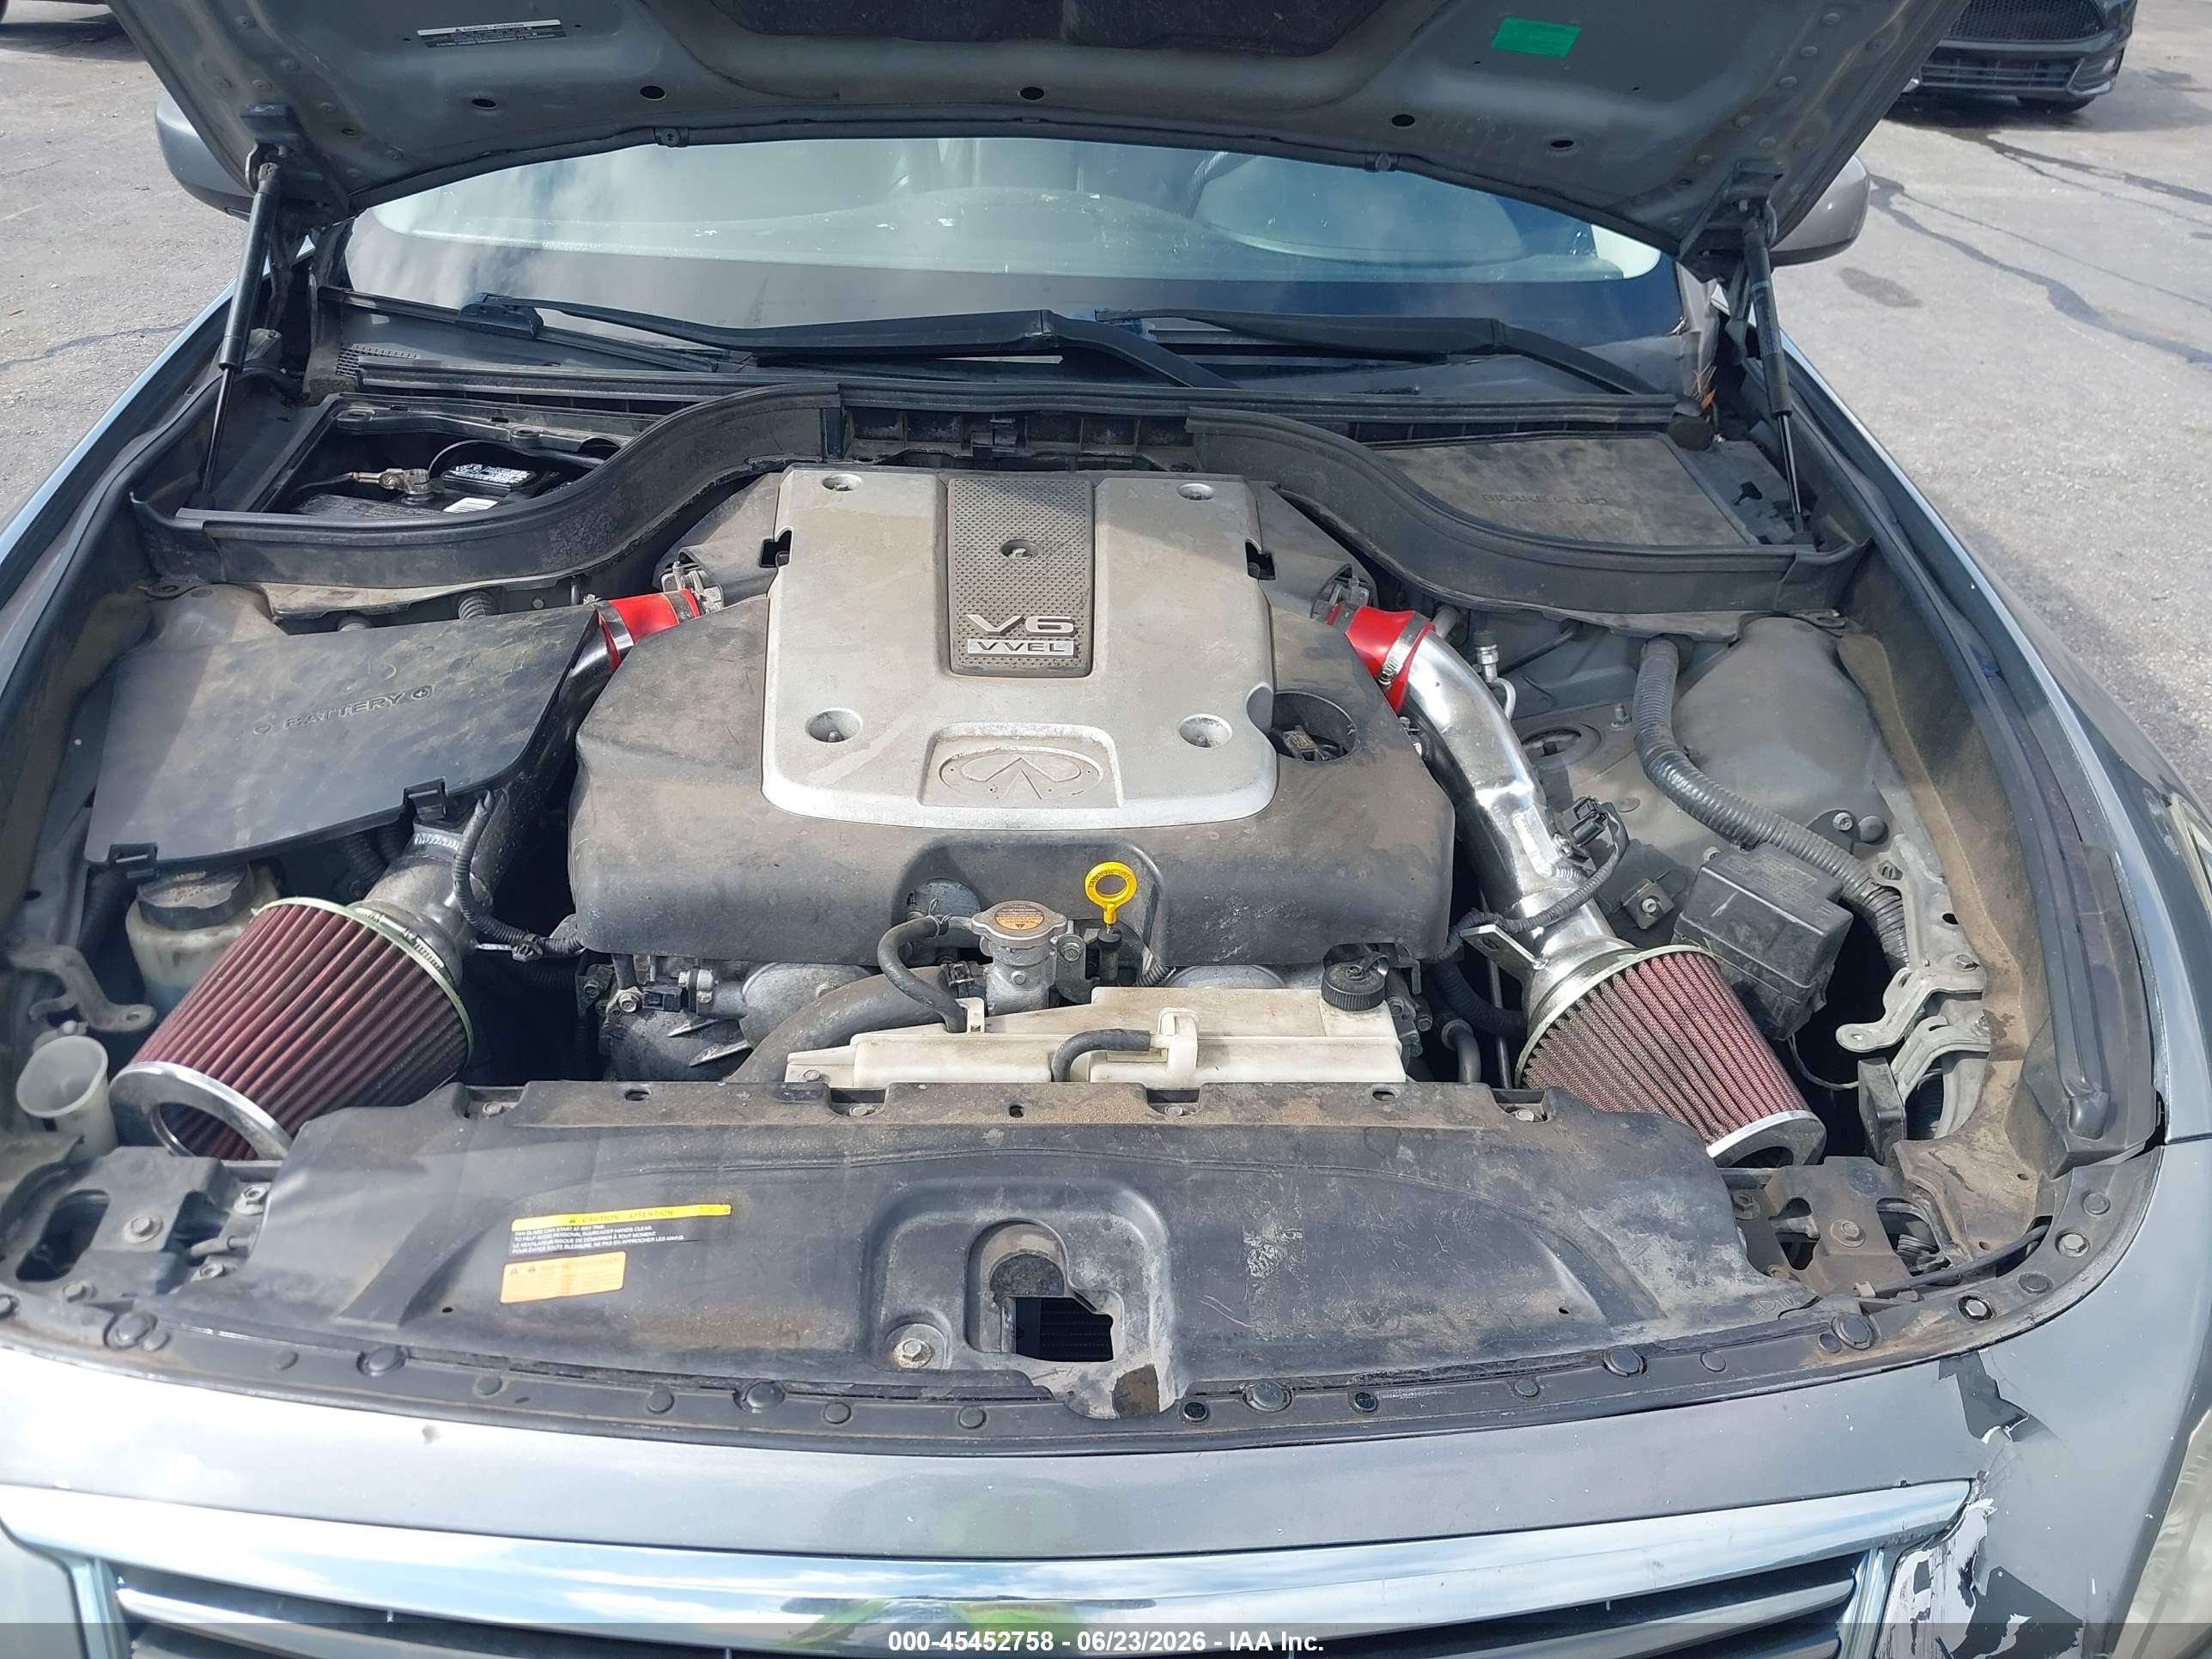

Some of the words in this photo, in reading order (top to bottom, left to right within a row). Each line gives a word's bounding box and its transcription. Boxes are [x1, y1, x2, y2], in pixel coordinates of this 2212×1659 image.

[966, 613, 1074, 635] V6
[977, 641, 1066, 653] VVEL
[283, 693, 405, 729] BATTERY
